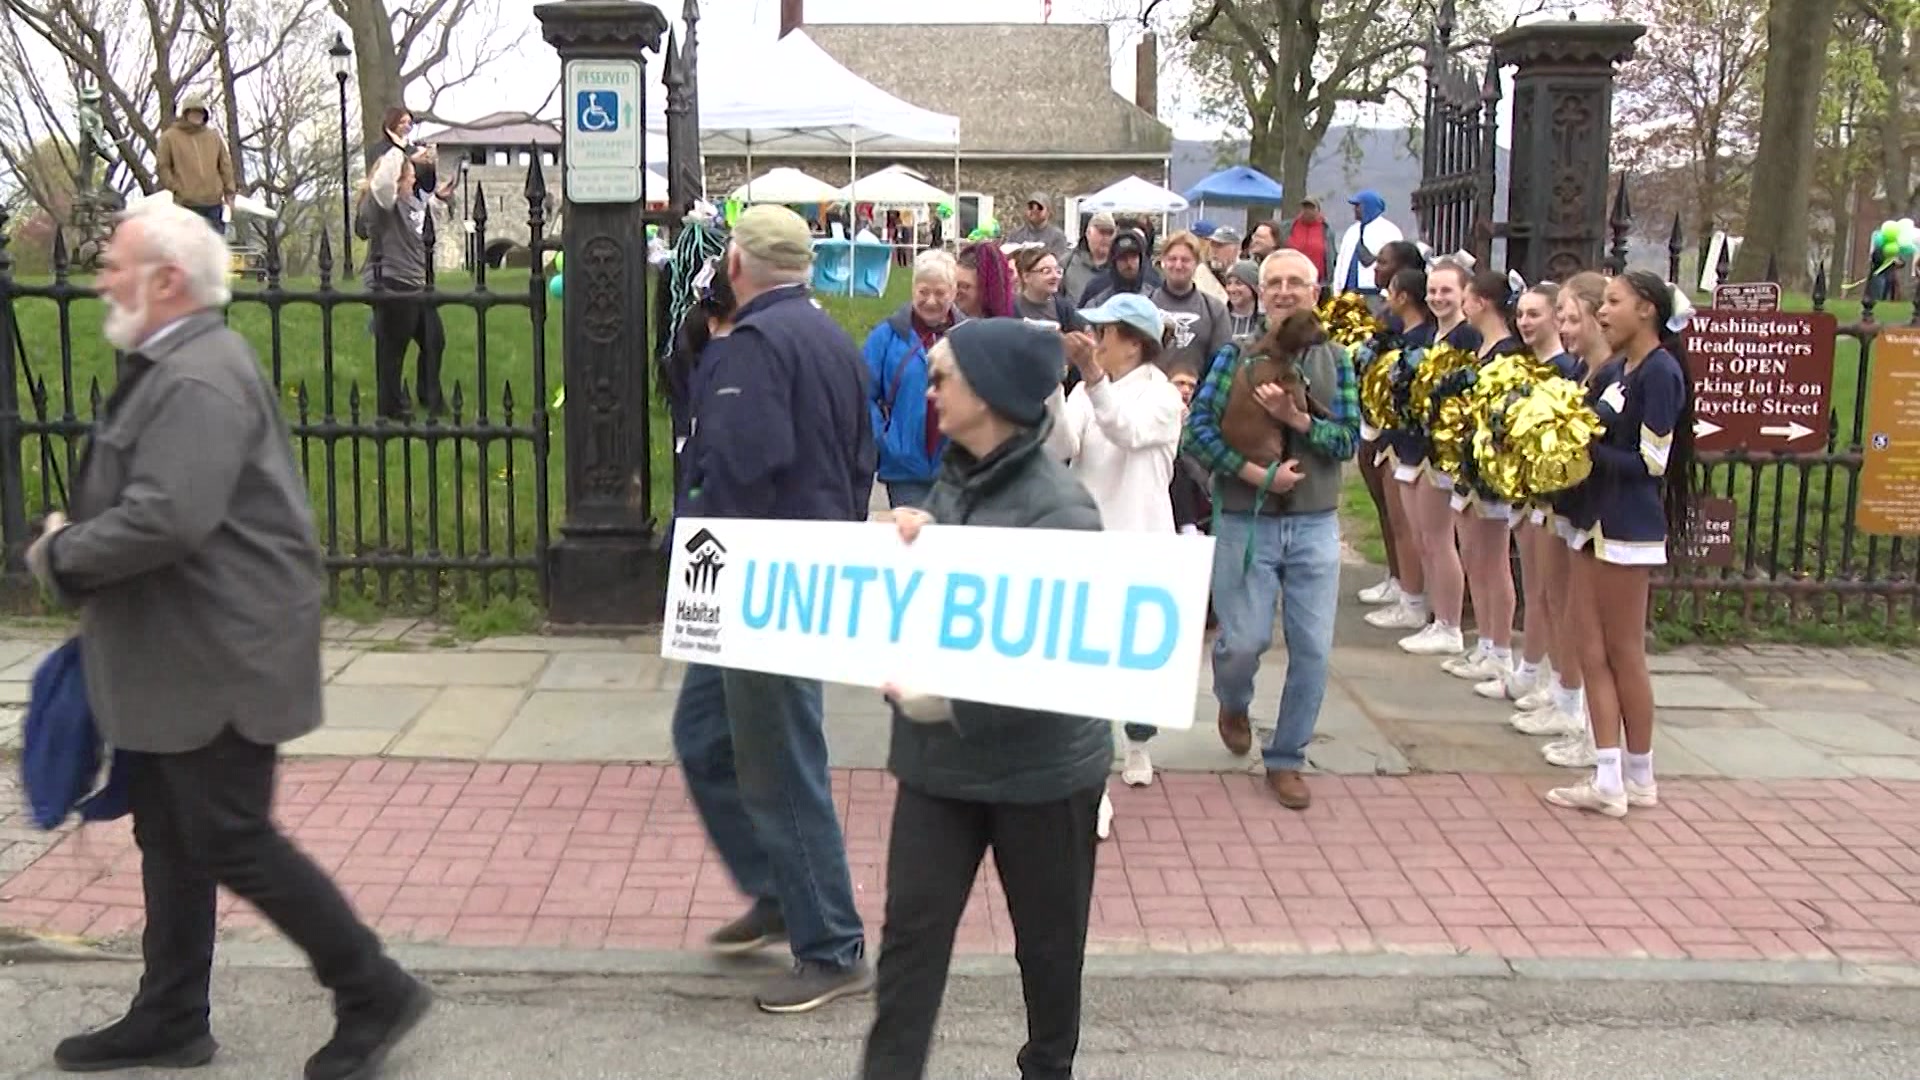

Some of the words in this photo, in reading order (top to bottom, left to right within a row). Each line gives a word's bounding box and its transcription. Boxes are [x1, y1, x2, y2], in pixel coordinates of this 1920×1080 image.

[577, 71, 629, 84] RESERVED
[1692, 317, 1812, 337] Washington's
[1687, 337, 1812, 357] Headquarters
[1709, 357, 1724, 373] is
[1729, 358, 1787, 374] OPEN
[1694, 377, 1745, 397] rking
[1749, 378, 1773, 395] lot
[1779, 378, 1794, 395] is
[1799, 383, 1821, 395] on
[1694, 397, 1757, 416] fayette
[1761, 398, 1819, 415] Street
[676, 600, 720, 624] Habitat
[742, 559, 925, 643] UNITY
[938, 572, 1180, 671] BUILD
